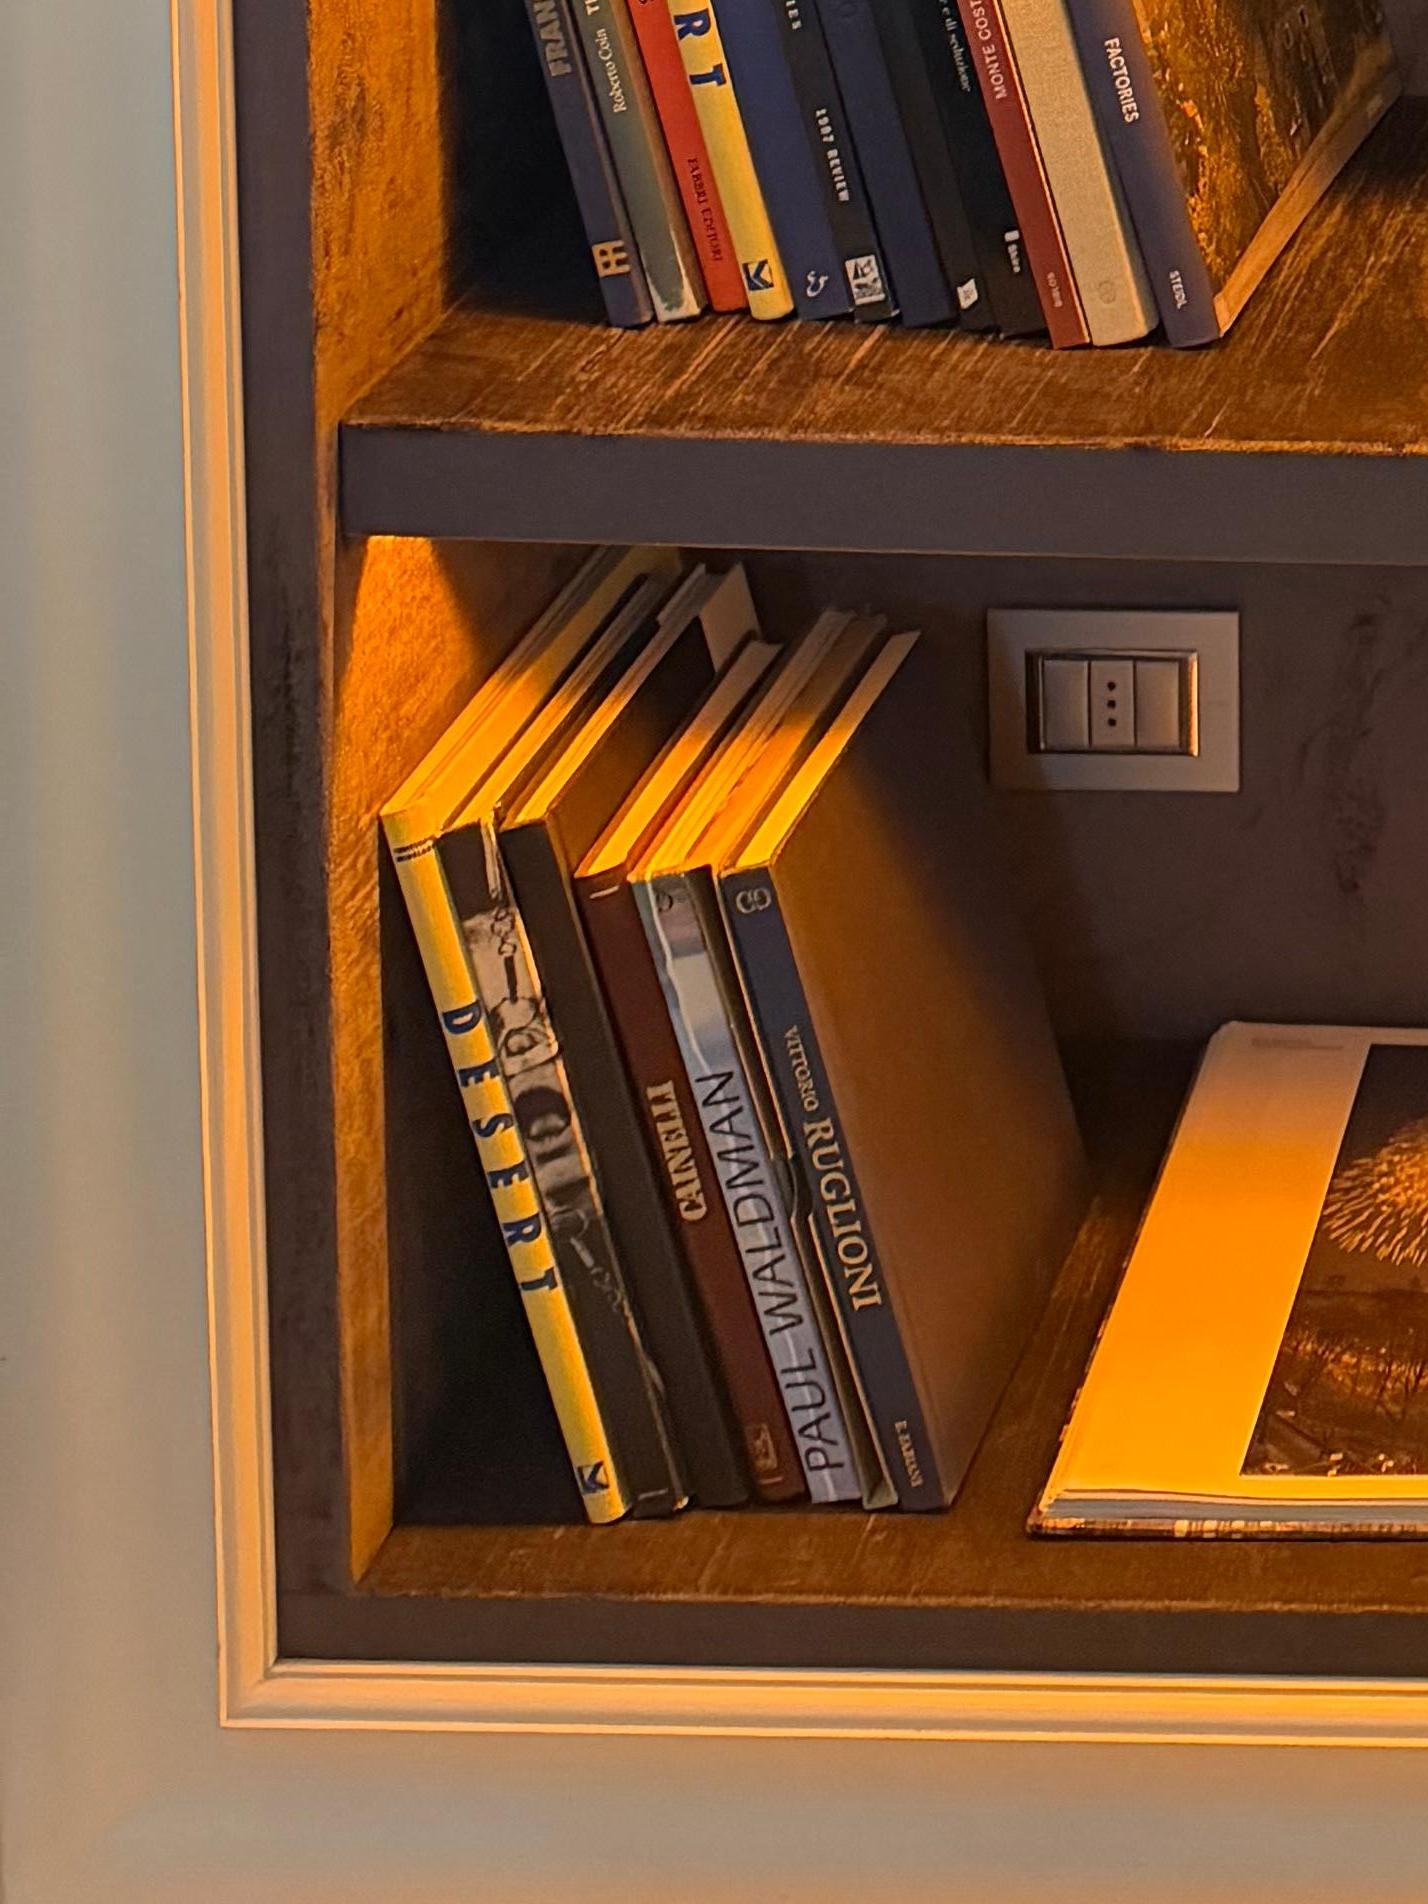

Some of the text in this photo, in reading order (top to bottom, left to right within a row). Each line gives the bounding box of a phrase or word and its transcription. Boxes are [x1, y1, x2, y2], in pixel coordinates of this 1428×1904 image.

[981, 44, 1009, 101] MONTE
[1104, 37, 1140, 124] FACTORIES
[442, 999, 559, 1293] DESERT
[694, 1070, 845, 1474] PAUL WALDMAN
[783, 1023, 882, 1313] VITTORIO RUGLIONI
